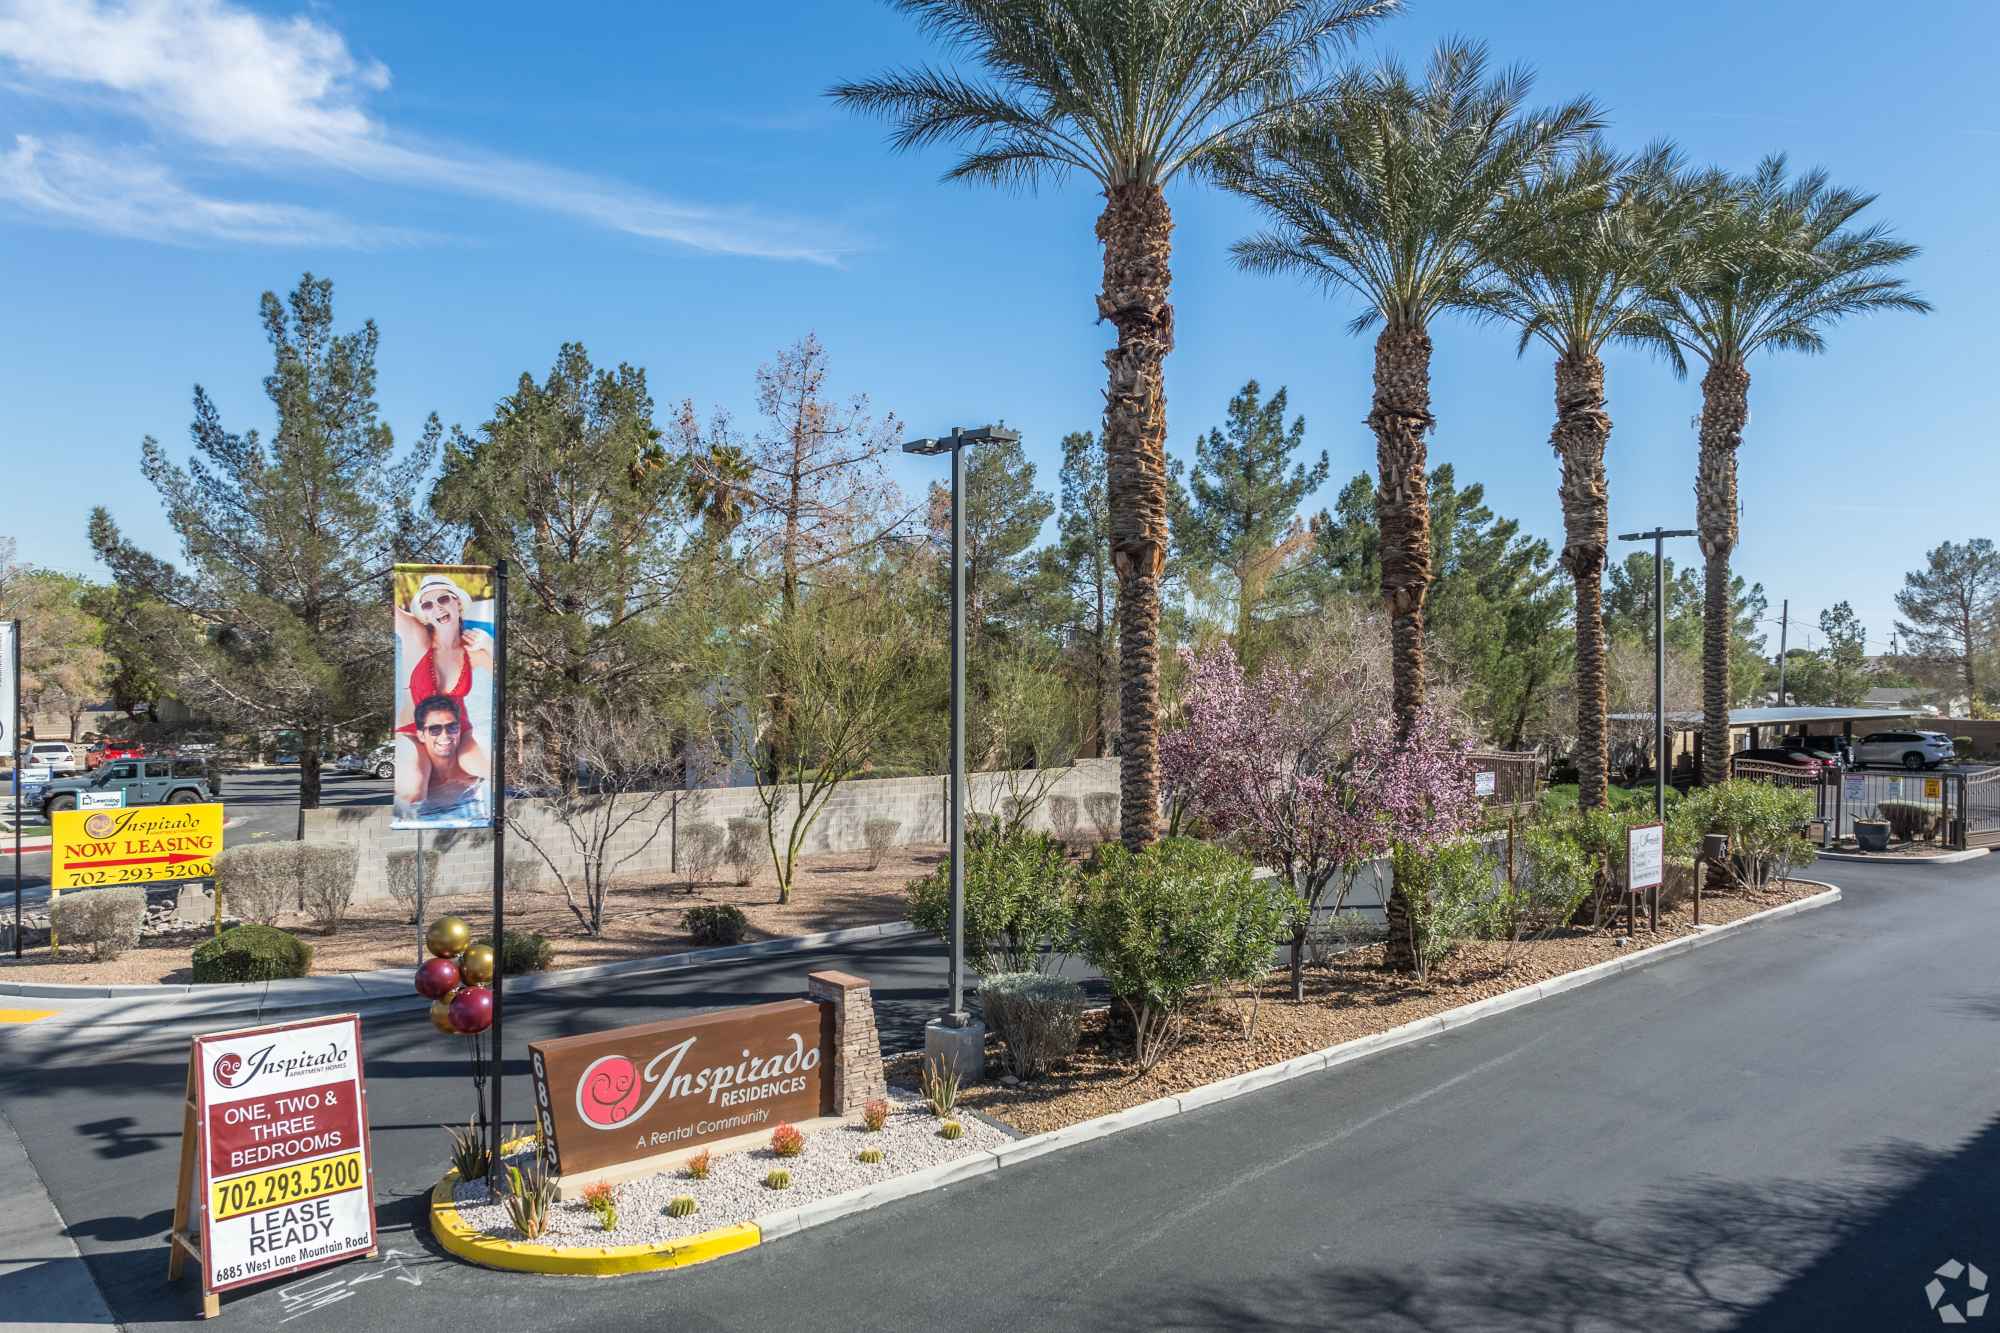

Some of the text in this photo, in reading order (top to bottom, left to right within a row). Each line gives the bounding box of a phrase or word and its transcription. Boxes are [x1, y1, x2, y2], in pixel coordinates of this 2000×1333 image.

[112, 810, 200, 837] Inspirado
[64, 835, 213, 859] NOW LEASING
[69, 862, 214, 887] 702-293-5200
[243, 1042, 348, 1080] Inspirado
[641, 1033, 820, 1113] Inspirado
[224, 1090, 338, 1125] ONE, TWO &
[534, 1052, 558, 1165] 6885
[721, 1076, 807, 1108] RESIDENCES
[250, 1115, 316, 1142] THREE
[635, 1107, 771, 1149] A Rental Community
[230, 1130, 342, 1169] BEDROOMS
[218, 1158, 360, 1215] 702.293.5200
[250, 1199, 332, 1236] LEASE
[249, 1217, 335, 1257] READY
[216, 1231, 370, 1283] 6885 West Lone Mountain Road
